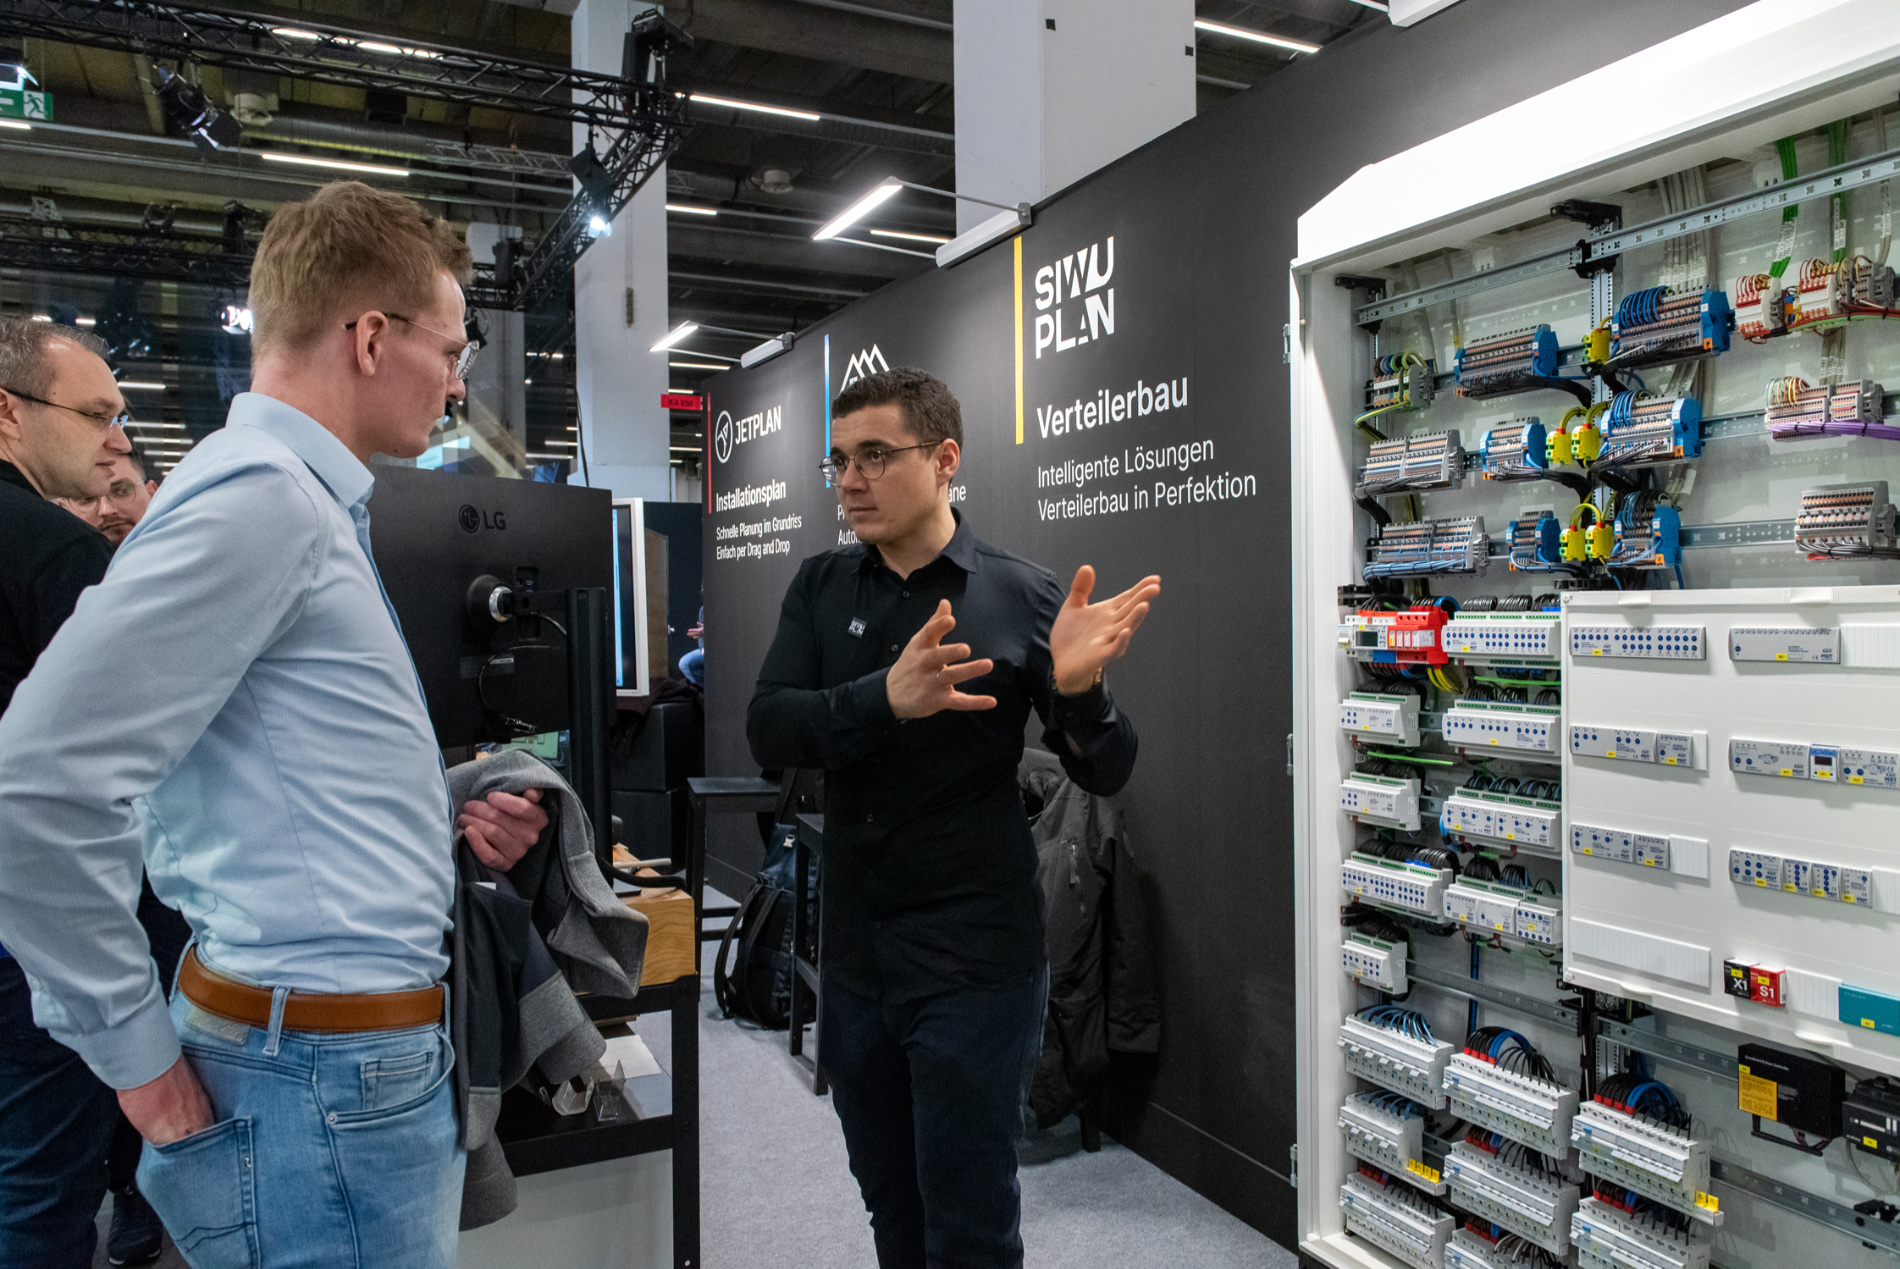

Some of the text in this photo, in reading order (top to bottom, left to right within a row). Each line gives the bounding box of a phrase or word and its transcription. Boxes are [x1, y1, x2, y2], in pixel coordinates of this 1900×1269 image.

[1035, 236, 1114, 310] SIWU
[1036, 288, 1114, 359] PLAN
[735, 405, 782, 444] JETPLAN
[1037, 377, 1188, 439] Verteilerbau
[1038, 439, 1214, 488] Intelligente Lösungen
[716, 479, 787, 512] Installationsplan
[1038, 471, 1256, 521] Verteilerbau in Perfektion
[483, 510, 506, 530] LG
[716, 513, 802, 540] Schnelle Planung im Grundriss
[716, 538, 790, 561] Einfach per Drag and Drop
[837, 528, 862, 546] Auto
[1733, 977, 1748, 991] X1
[1760, 985, 1774, 999] S1
